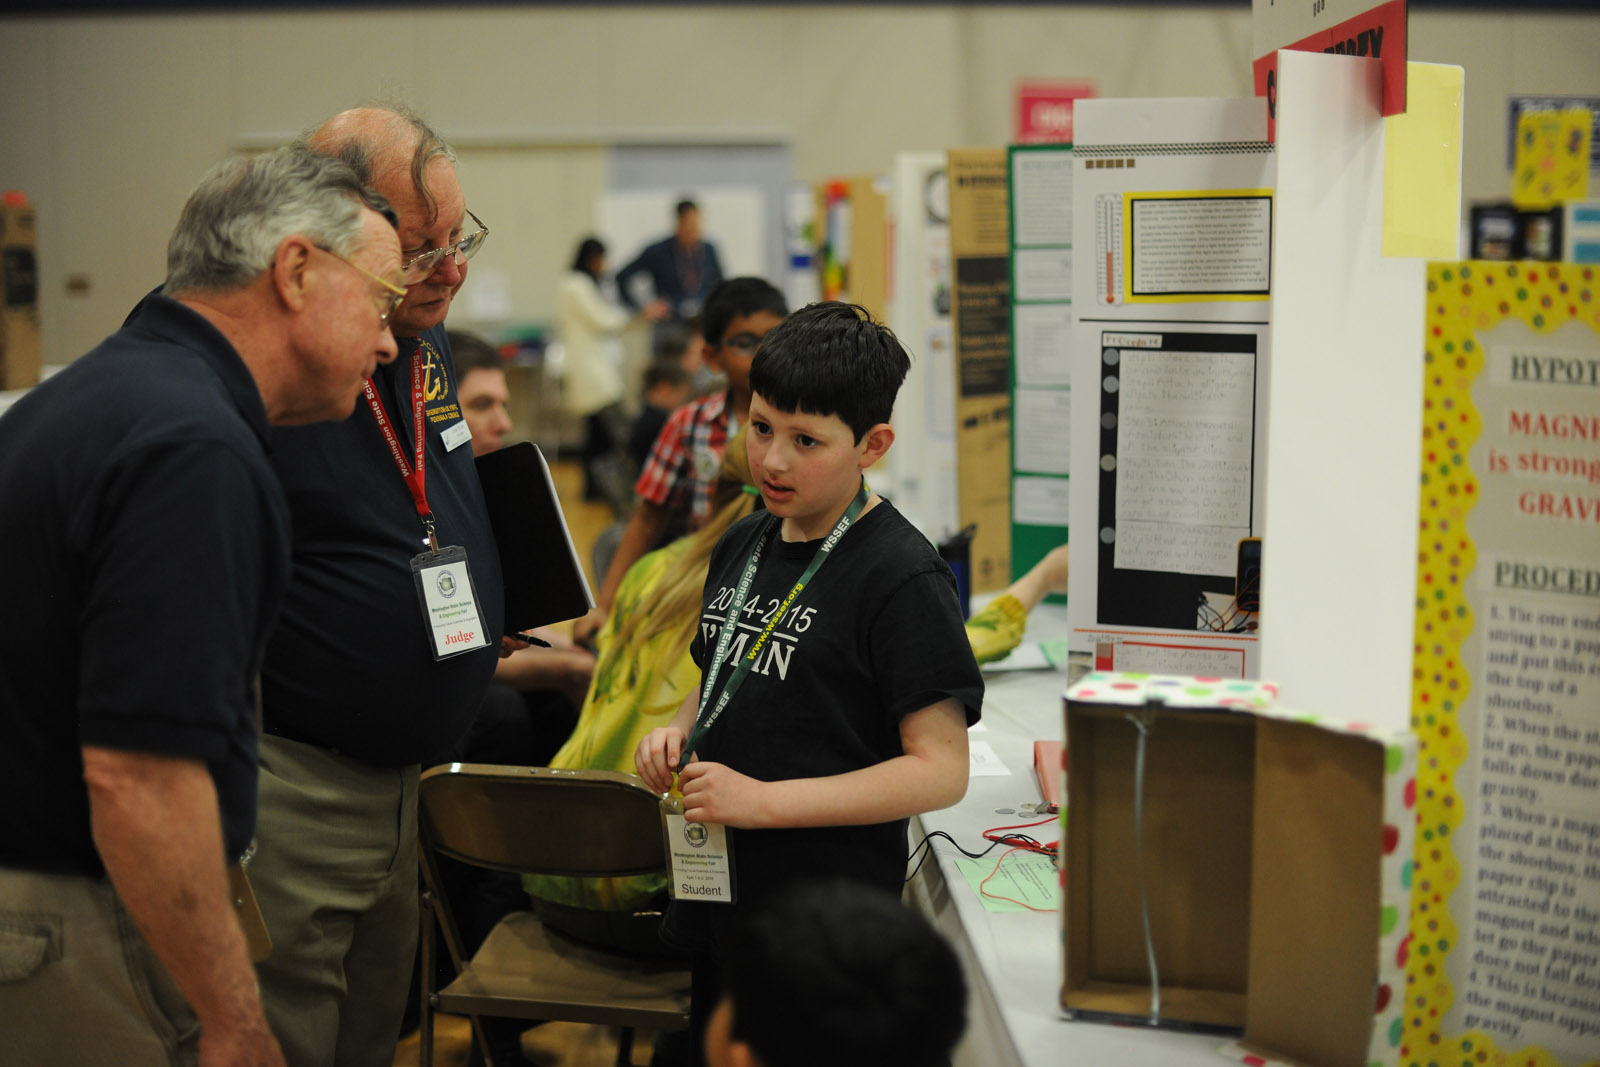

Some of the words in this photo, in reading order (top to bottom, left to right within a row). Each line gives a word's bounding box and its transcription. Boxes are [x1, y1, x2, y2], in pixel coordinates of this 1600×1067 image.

[413, 354, 421, 390] Science
[1510, 355, 1600, 387] HYPOT
[371, 400, 386, 425] State
[415, 401, 423, 453] Engineering
[383, 426, 410, 477] Washington
[1489, 450, 1509, 472] is
[1517, 450, 1600, 484] strong
[820, 516, 850, 554] WSSEF
[734, 562, 758, 607] Science
[1495, 561, 1600, 597] PROCED
[728, 609, 740, 631] and
[747, 582, 804, 661] www.wssef.org
[445, 631, 475, 646] Judge
[702, 632, 733, 699] Engineering
[1488, 651, 1518, 666] and
[1486, 670, 1512, 687] the
[703, 690, 730, 728] WSSEF
[1503, 716, 1551, 738] When
[1535, 743, 1562, 761] the
[1519, 763, 1566, 784] down
[1569, 770, 1599, 791] due
[1501, 804, 1547, 825] When
[1478, 844, 1504, 863] the
[1480, 824, 1534, 846] placed
[1555, 836, 1582, 854] the
[681, 883, 722, 896] Student
[1478, 867, 1523, 887] paper
[1528, 875, 1558, 897] clip
[1561, 882, 1576, 898] is
[1477, 888, 1551, 915] attracted
[1553, 902, 1570, 917] to
[1574, 906, 1599, 924] the
[1476, 909, 1535, 930] magnet
[1539, 923, 1570, 939] and
[1474, 927, 1495, 944] let
[1498, 936, 1518, 952] go
[1521, 938, 1548, 955] the
[1550, 947, 1597, 969] paper
[1473, 949, 1511, 969] does
[1514, 960, 1541, 976] not
[1544, 962, 1571, 984] fall
[1487, 973, 1520, 995] This
[1523, 982, 1538, 998] is
[1466, 991, 1492, 1008] the
[1494, 1000, 1555, 1025] magnet
